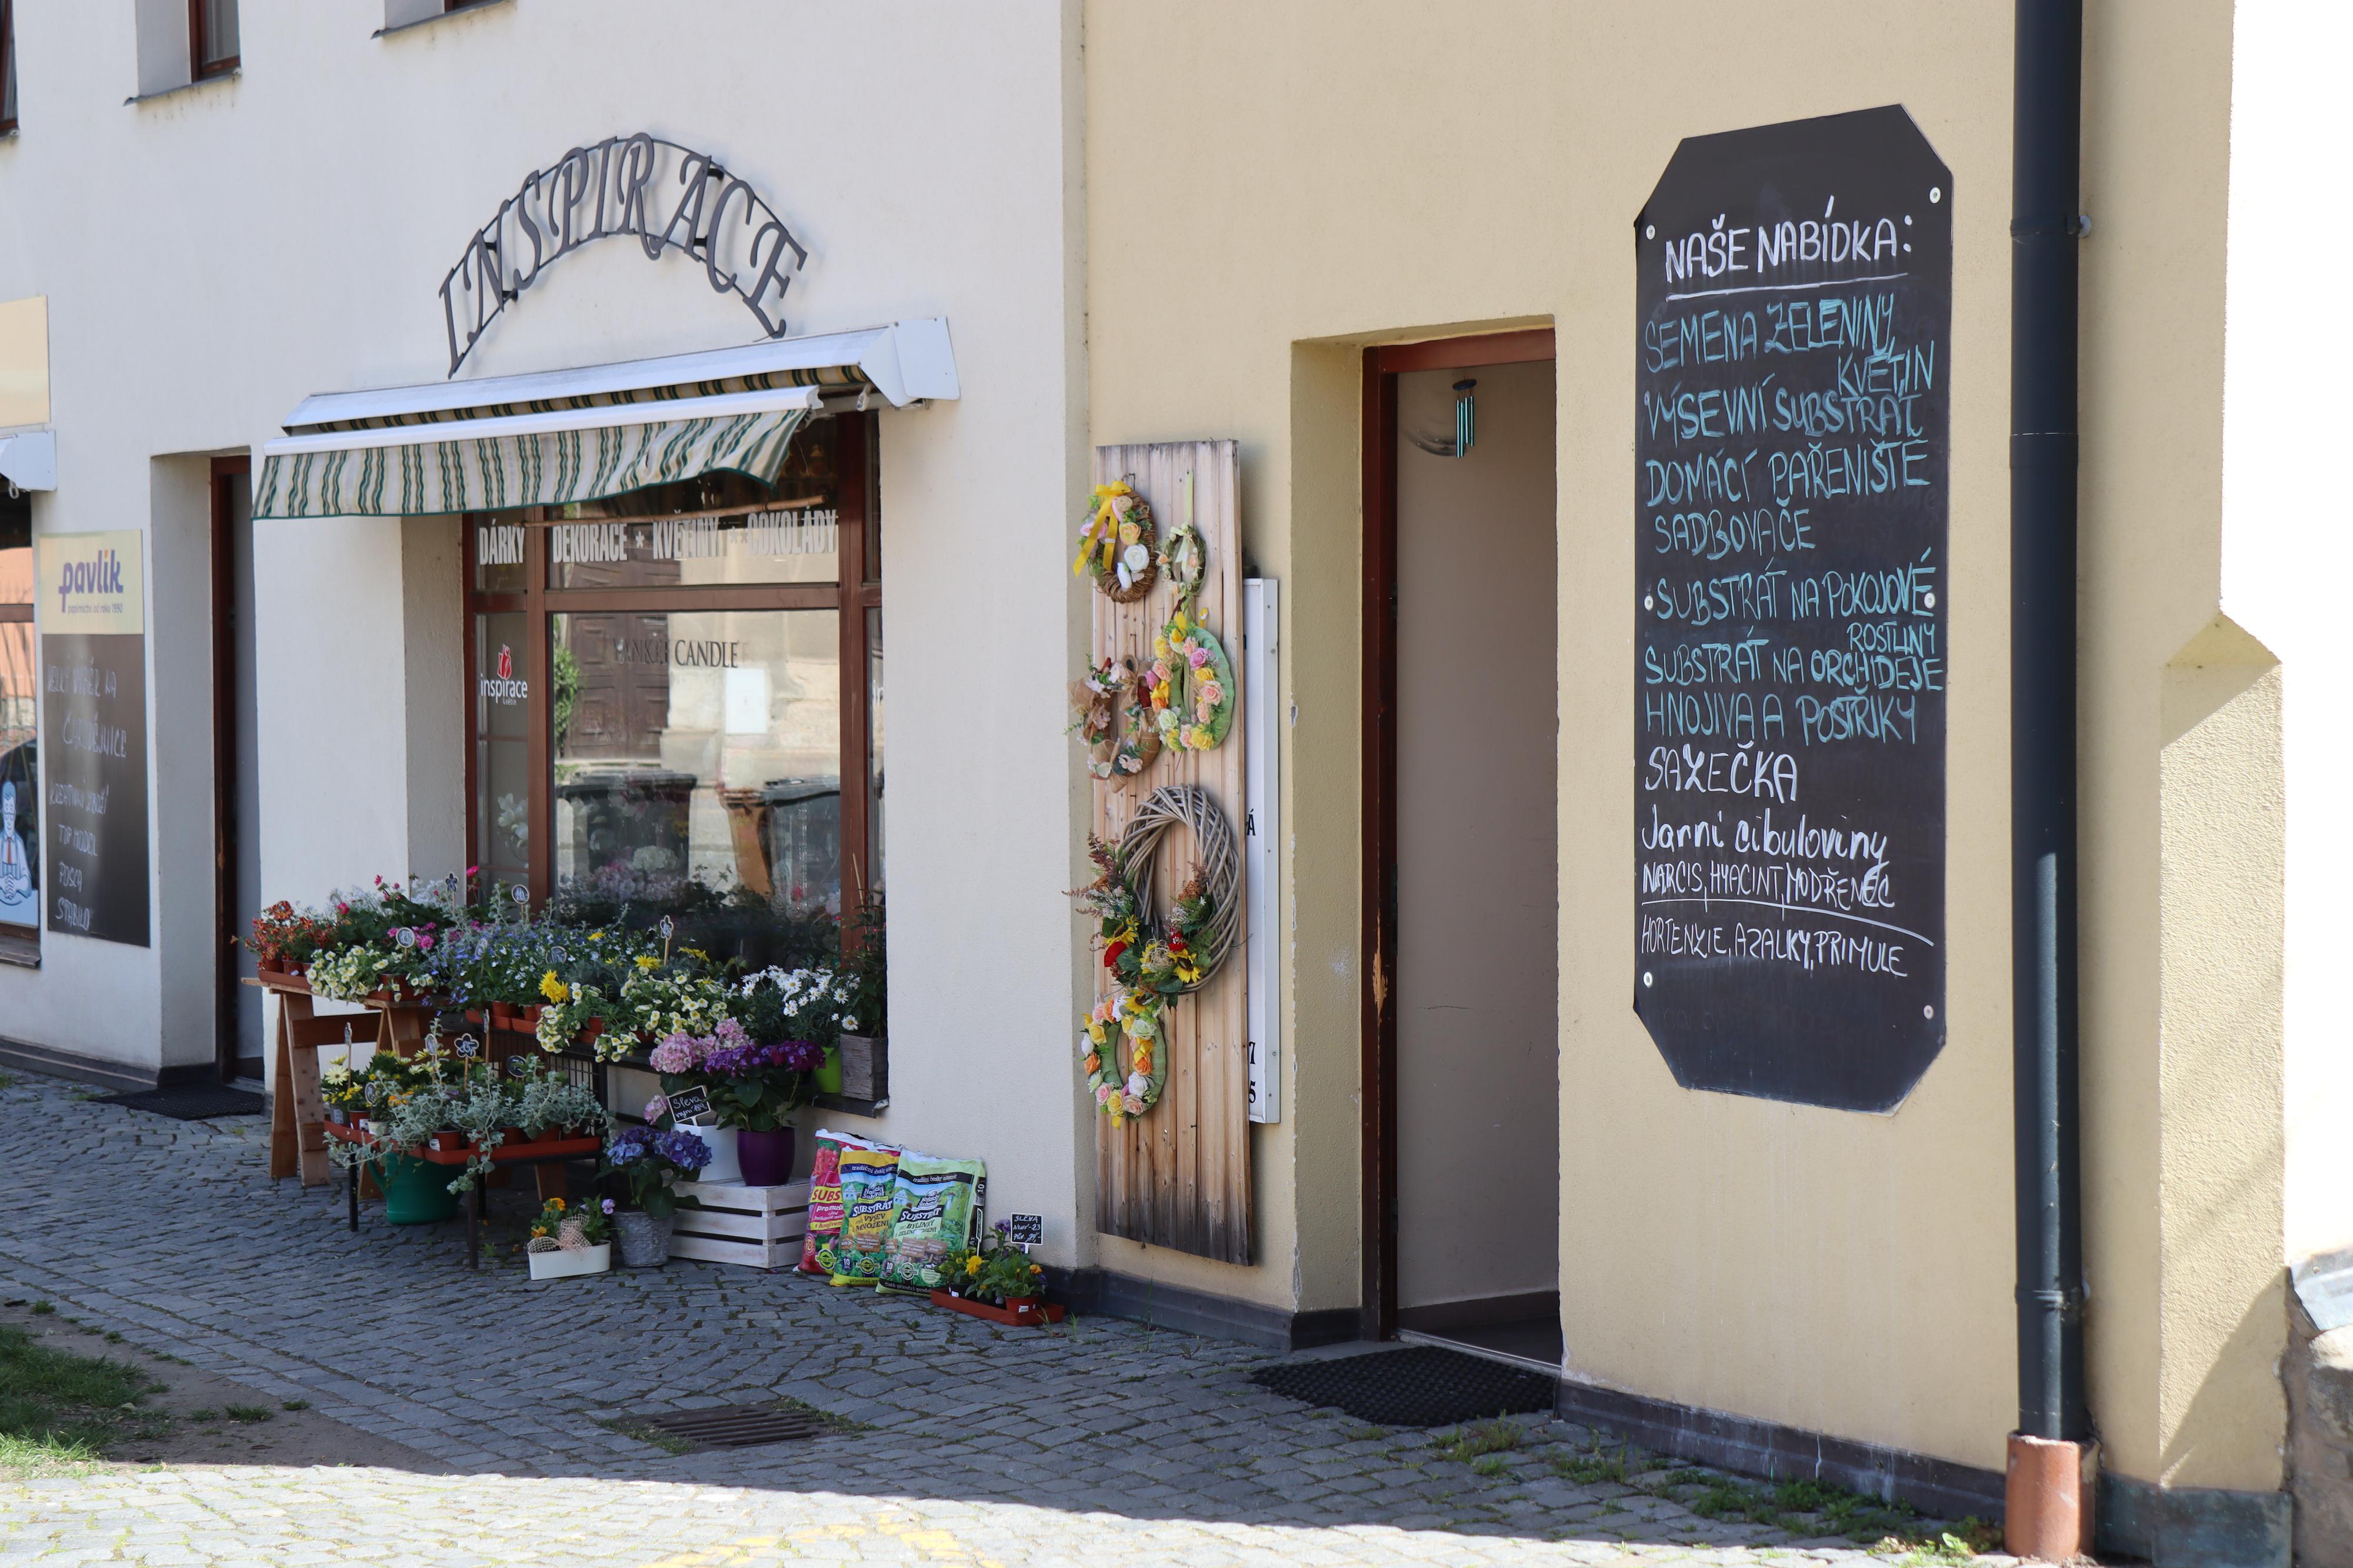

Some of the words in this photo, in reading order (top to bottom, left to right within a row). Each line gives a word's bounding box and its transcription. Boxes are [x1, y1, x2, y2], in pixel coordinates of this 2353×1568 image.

[439, 132, 808, 380] INSPIRACE
[1665, 213, 1750, 283] NAŠE
[1757, 195, 1913, 273] NABÍDKA:
[1647, 310, 1758, 373] SEMENA
[1644, 373, 1775, 447] VÝSEVNÍ
[1645, 448, 1758, 507] DOMÁCÍ
[479, 518, 525, 565] DÁRKY
[552, 523, 628, 563] DEKORACE
[652, 509, 719, 559] KVĚTINY
[1655, 495, 1816, 561] SADBOVAČE
[1656, 556, 1788, 625] SUBSTRÁT
[1791, 578, 1819, 621] NA
[1822, 546, 1937, 619] POKOJOVÉ
[675, 640, 739, 668] CANDLE
[1645, 625, 1769, 686] SUBSTRÁT
[1772, 647, 1805, 684] NA
[1810, 649, 1943, 691] ORCHIDEJE
[1846, 621, 1935, 655] ROSTLINY
[480, 673, 528, 704] inspirace
[1647, 691, 1754, 740] HNOJIVA
[1762, 694, 1785, 740] A
[1795, 684, 1916, 746] POSTŘIKY
[1813, 930, 1908, 977] PRIMULE
[673, 1096, 702, 1109] Sleva
[852, 1200, 893, 1217] SUBSTRÁT
[1014, 1215, 1038, 1223] SLEVA
